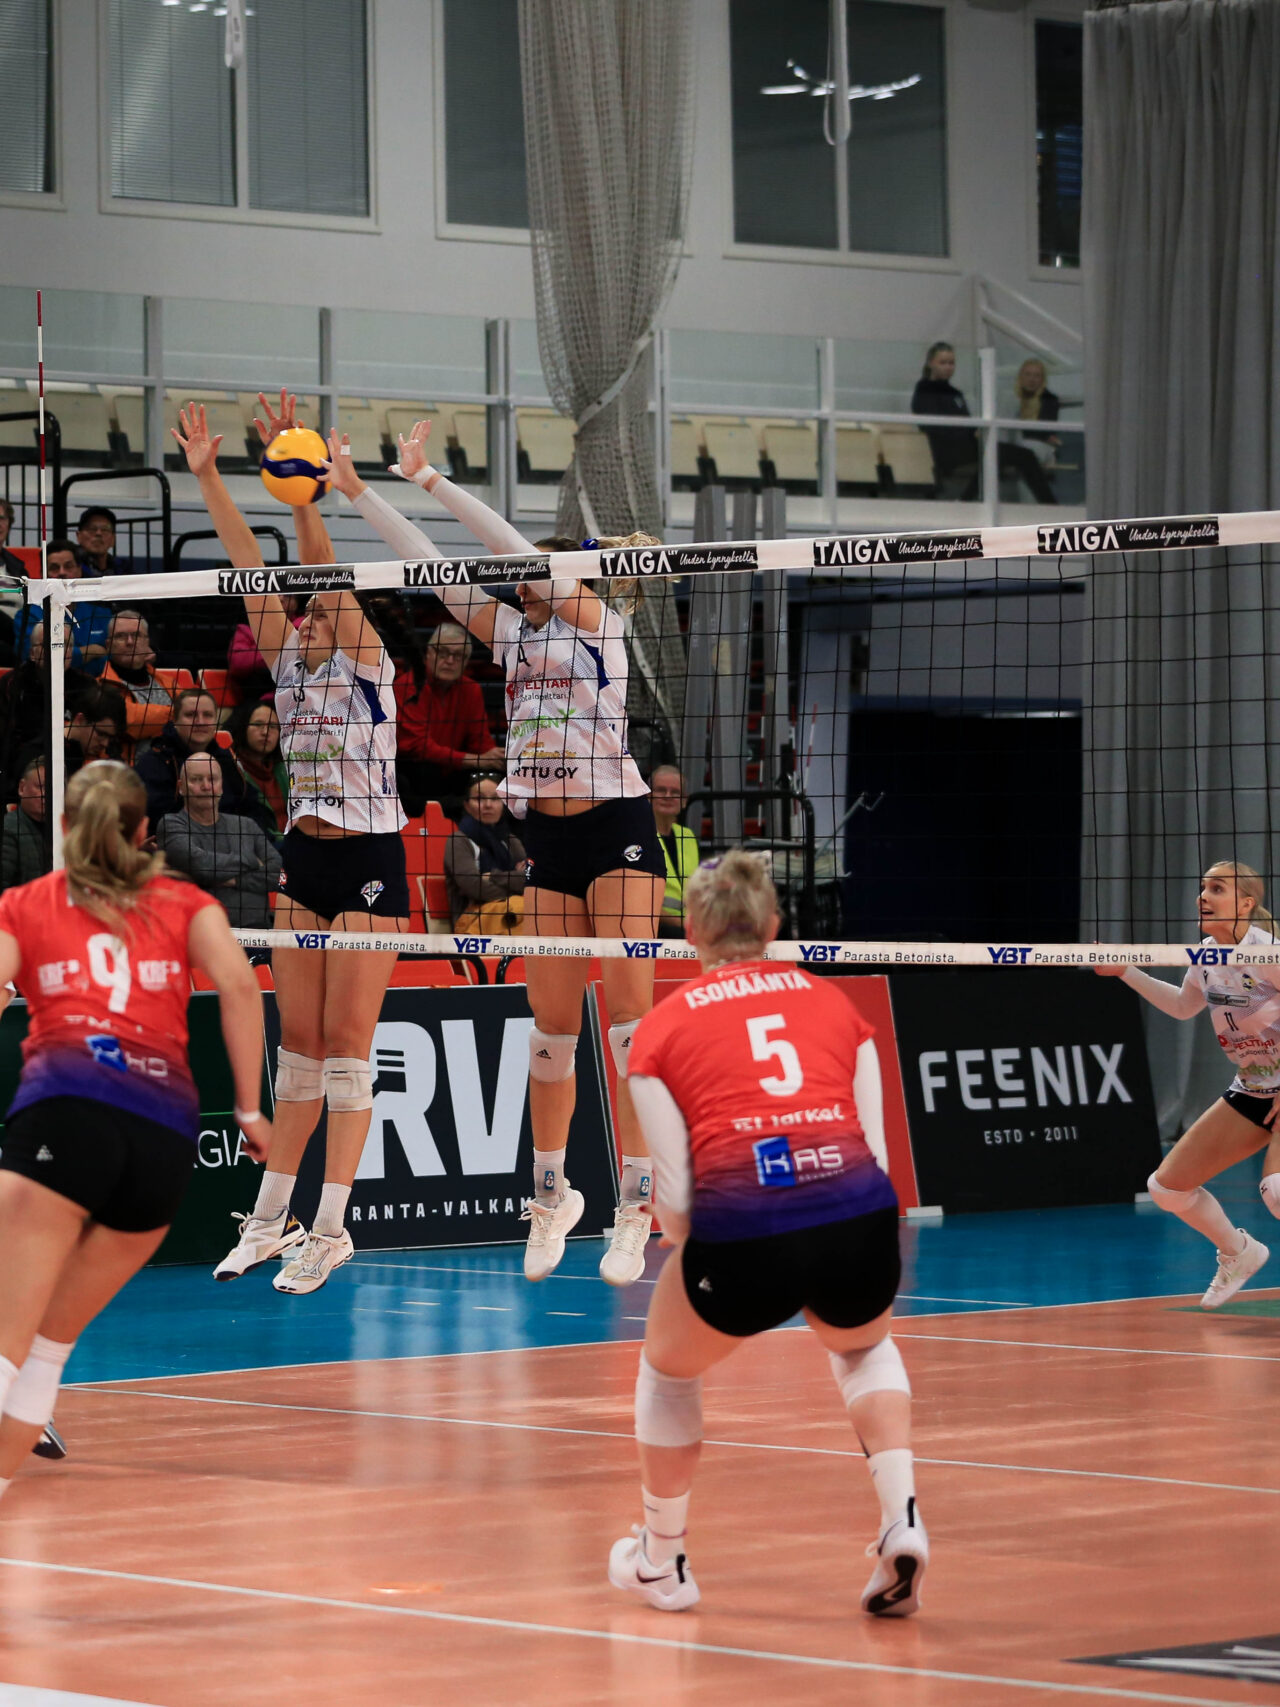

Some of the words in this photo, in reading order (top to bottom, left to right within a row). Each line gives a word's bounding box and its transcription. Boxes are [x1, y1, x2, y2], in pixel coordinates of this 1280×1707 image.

[1039, 525, 1119, 551] TAIGA
[1129, 527, 1159, 541] Uuden
[602, 550, 672, 575] TAIGA
[679, 553, 705, 565] Uuden
[815, 539, 890, 564] TAIGA
[898, 542, 926, 554] Uuden
[220, 571, 280, 592] TAIGA
[405, 561, 470, 584] TAIGA
[237, 938, 269, 947] onista.
[294, 933, 331, 949] YBT
[332, 940, 370, 950] Parasta
[375, 941, 427, 951] Betonista.
[453, 937, 492, 953] YBT
[493, 945, 534, 955] Parasta
[539, 945, 595, 957] Betonista.
[622, 942, 663, 958] YBT
[664, 948, 696, 958] Paras
[798, 944, 842, 962] YBT
[844, 951, 890, 962] Parasta
[895, 952, 957, 963] Betonista.
[987, 947, 1033, 964] YBT
[1034, 952, 1083, 963] Parasta
[1089, 951, 1154, 962] Betonista.
[1185, 948, 1234, 965] YBT
[1236, 953, 1280, 964] Parast
[87, 933, 131, 1013] 9
[684, 969, 812, 1009] ISOKÄÄNTÄ
[1224, 1012, 1239, 1032] 11
[746, 1013, 803, 1097] 5
[919, 1044, 1133, 1113] FEENIX
[984, 1129, 1022, 1144] ESTD
[1044, 1126, 1078, 1141] 2011
[193, 1128, 259, 1168] GIA
[763, 1145, 843, 1175] KAS
[352, 1196, 533, 1222] RANTA-VALKAM
